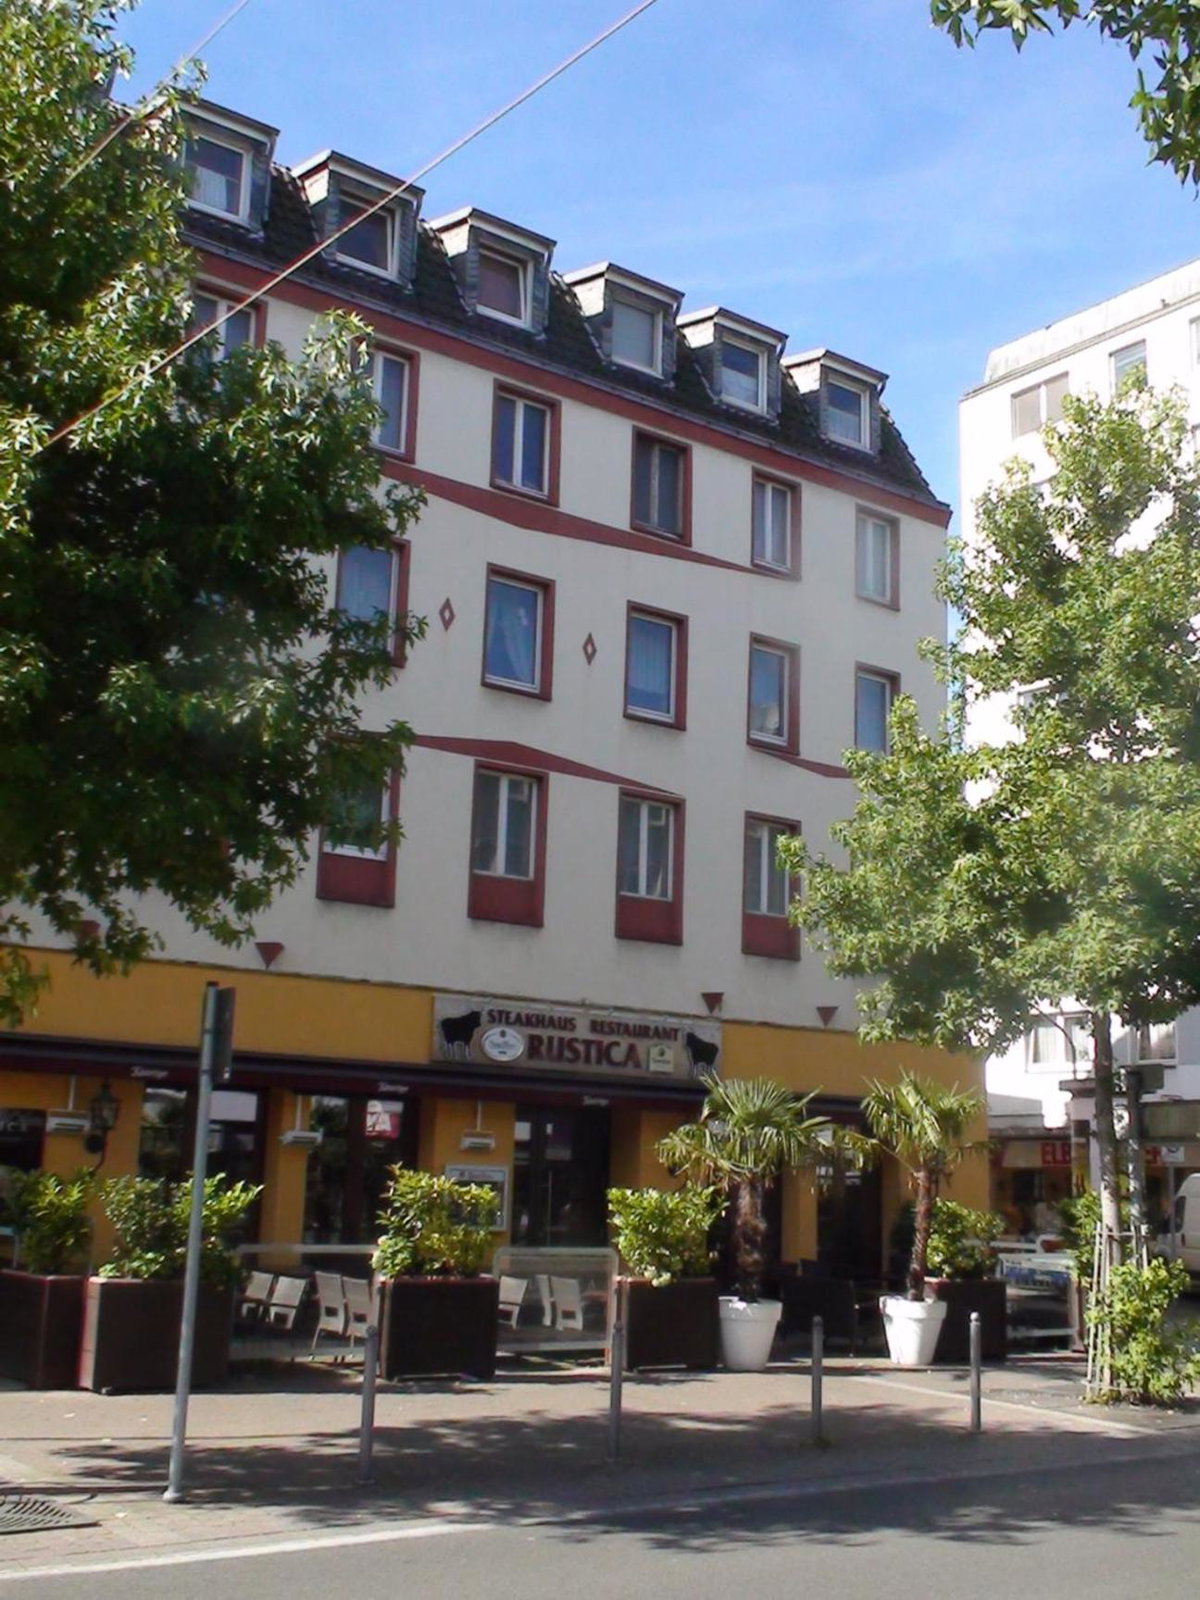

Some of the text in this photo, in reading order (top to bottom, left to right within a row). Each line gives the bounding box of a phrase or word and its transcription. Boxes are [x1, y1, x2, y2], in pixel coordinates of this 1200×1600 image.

[488, 1009, 679, 1041] STEAKHAUS RESTAURANT
[527, 1034, 642, 1069] RUSTICA
